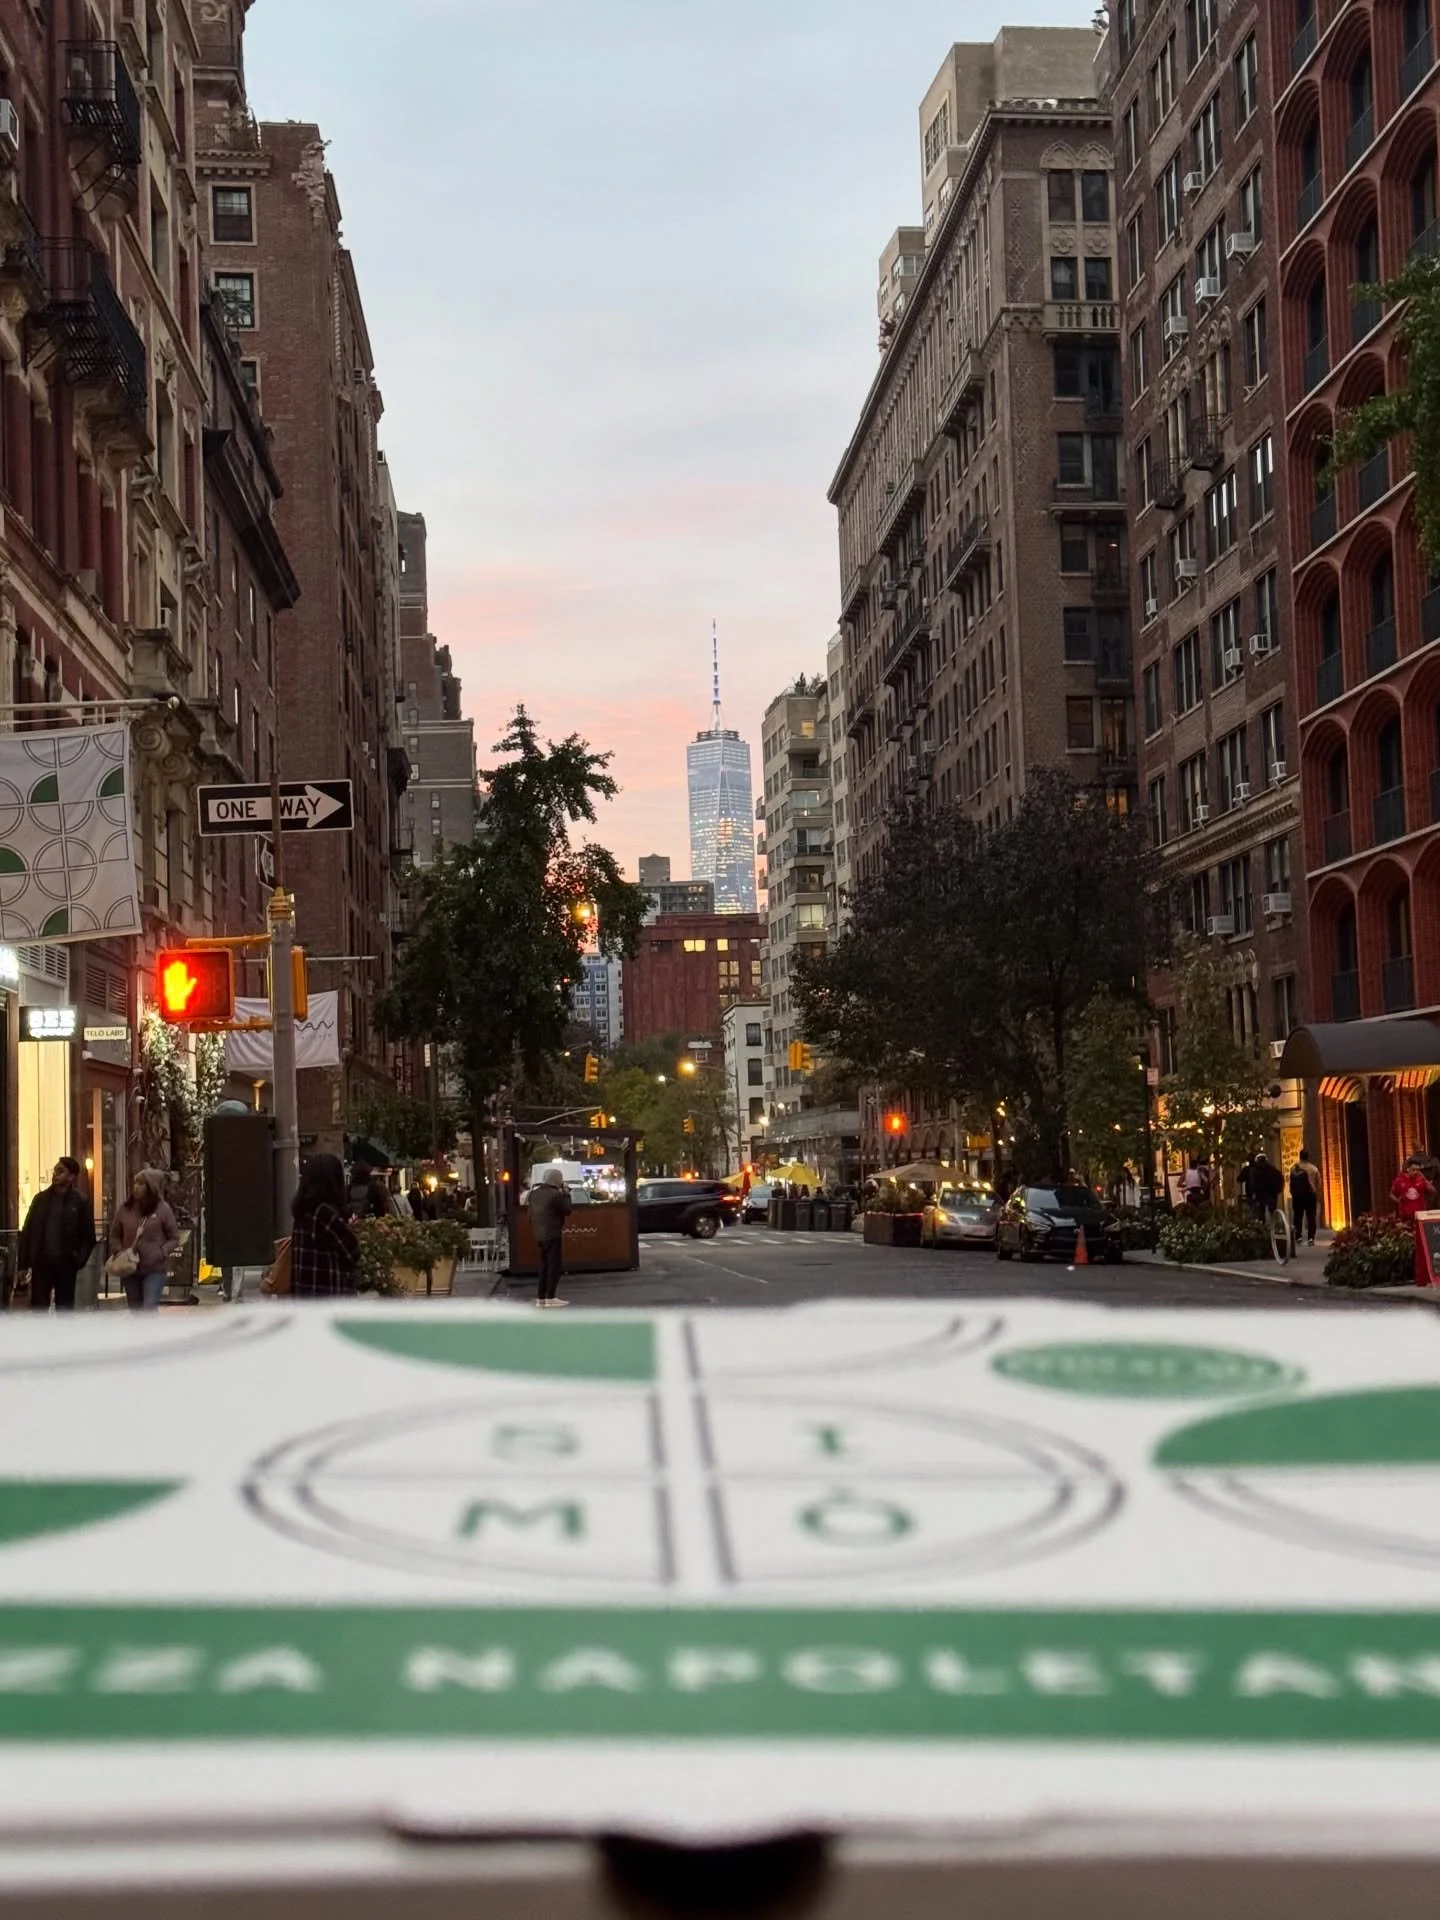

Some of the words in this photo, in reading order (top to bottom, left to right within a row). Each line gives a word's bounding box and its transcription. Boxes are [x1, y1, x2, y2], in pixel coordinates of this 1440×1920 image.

[216, 800, 257, 819] ONE
[280, 797, 321, 817] WAY
[106, 1029, 125, 1037] LABS
[492, 1424, 579, 1458] S
[456, 1498, 587, 1542] M
